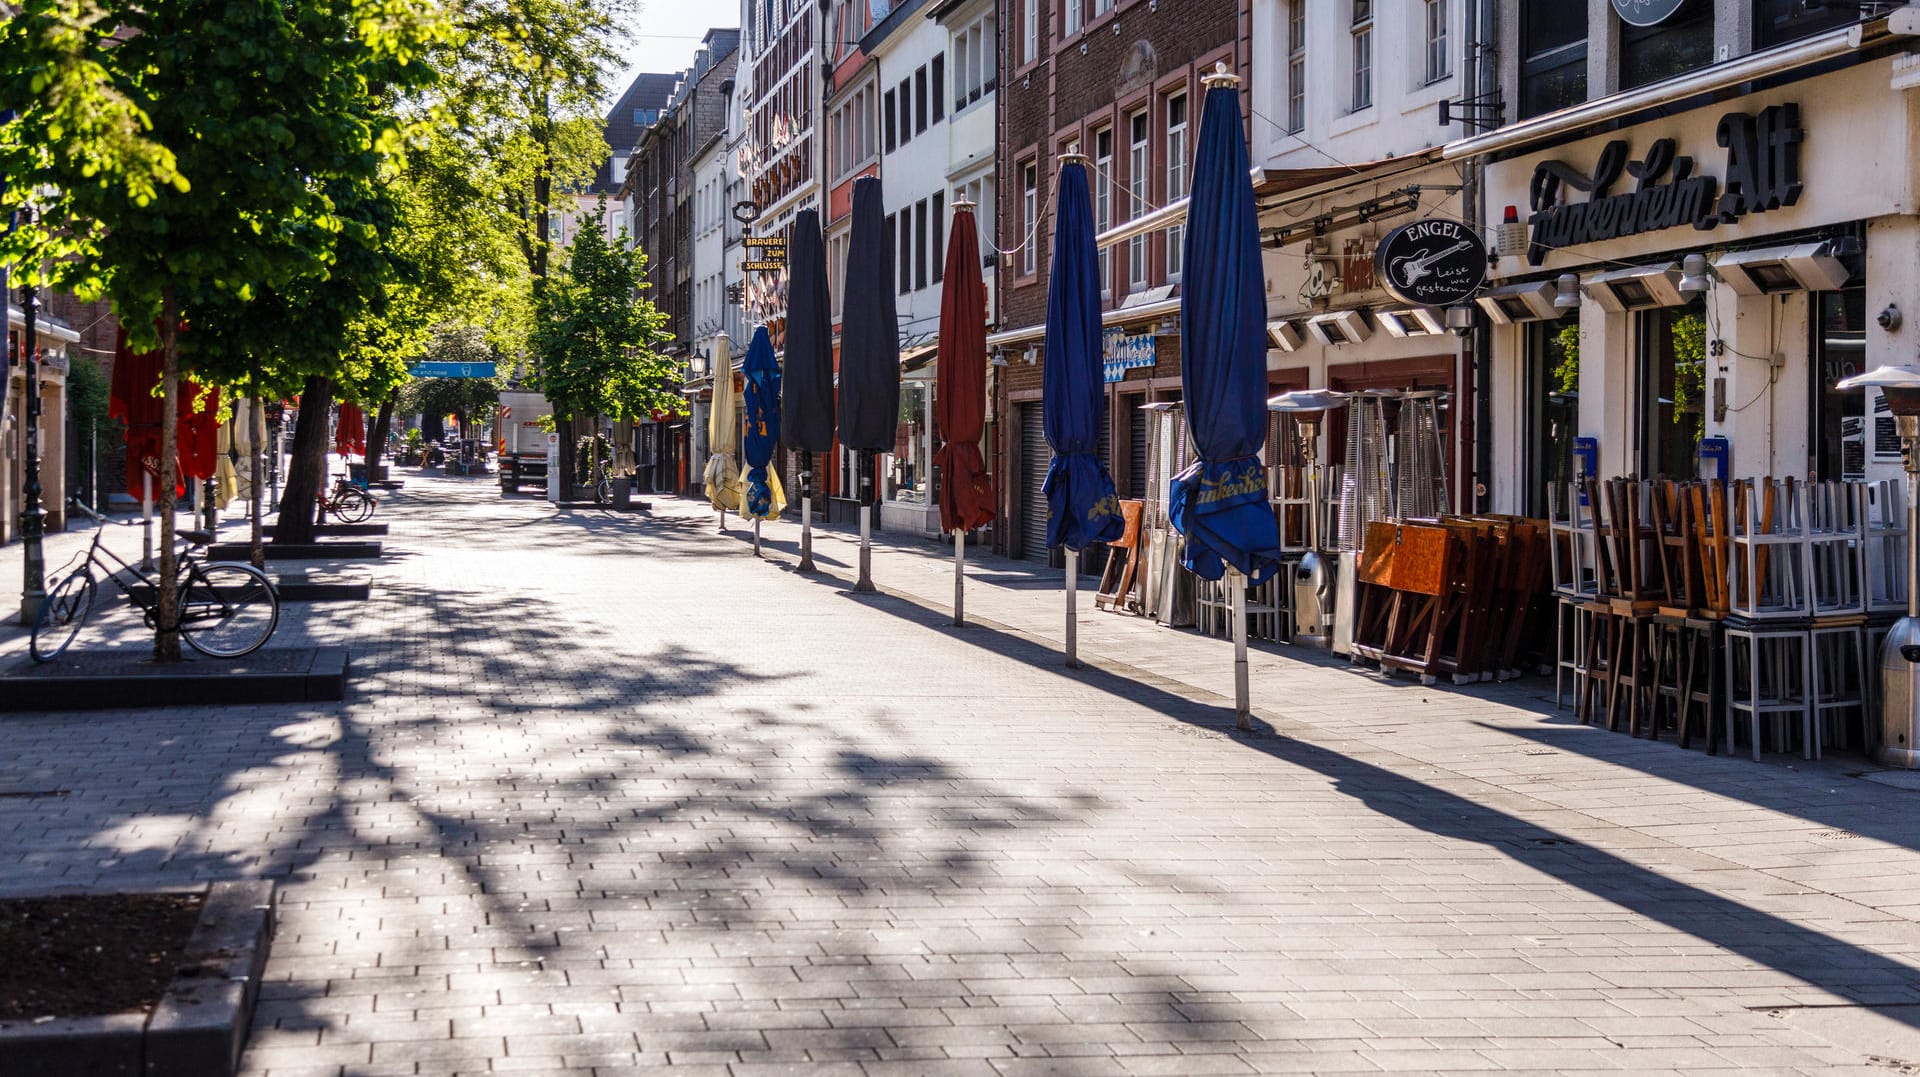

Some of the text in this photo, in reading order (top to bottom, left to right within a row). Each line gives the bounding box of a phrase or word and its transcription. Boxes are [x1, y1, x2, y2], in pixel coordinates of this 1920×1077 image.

[1527, 103, 1804, 266] Frankenheim Alt
[1405, 221, 1461, 241] ENGEL
[1436, 266, 1469, 277] Leise
[1710, 339, 1724, 357] 33
